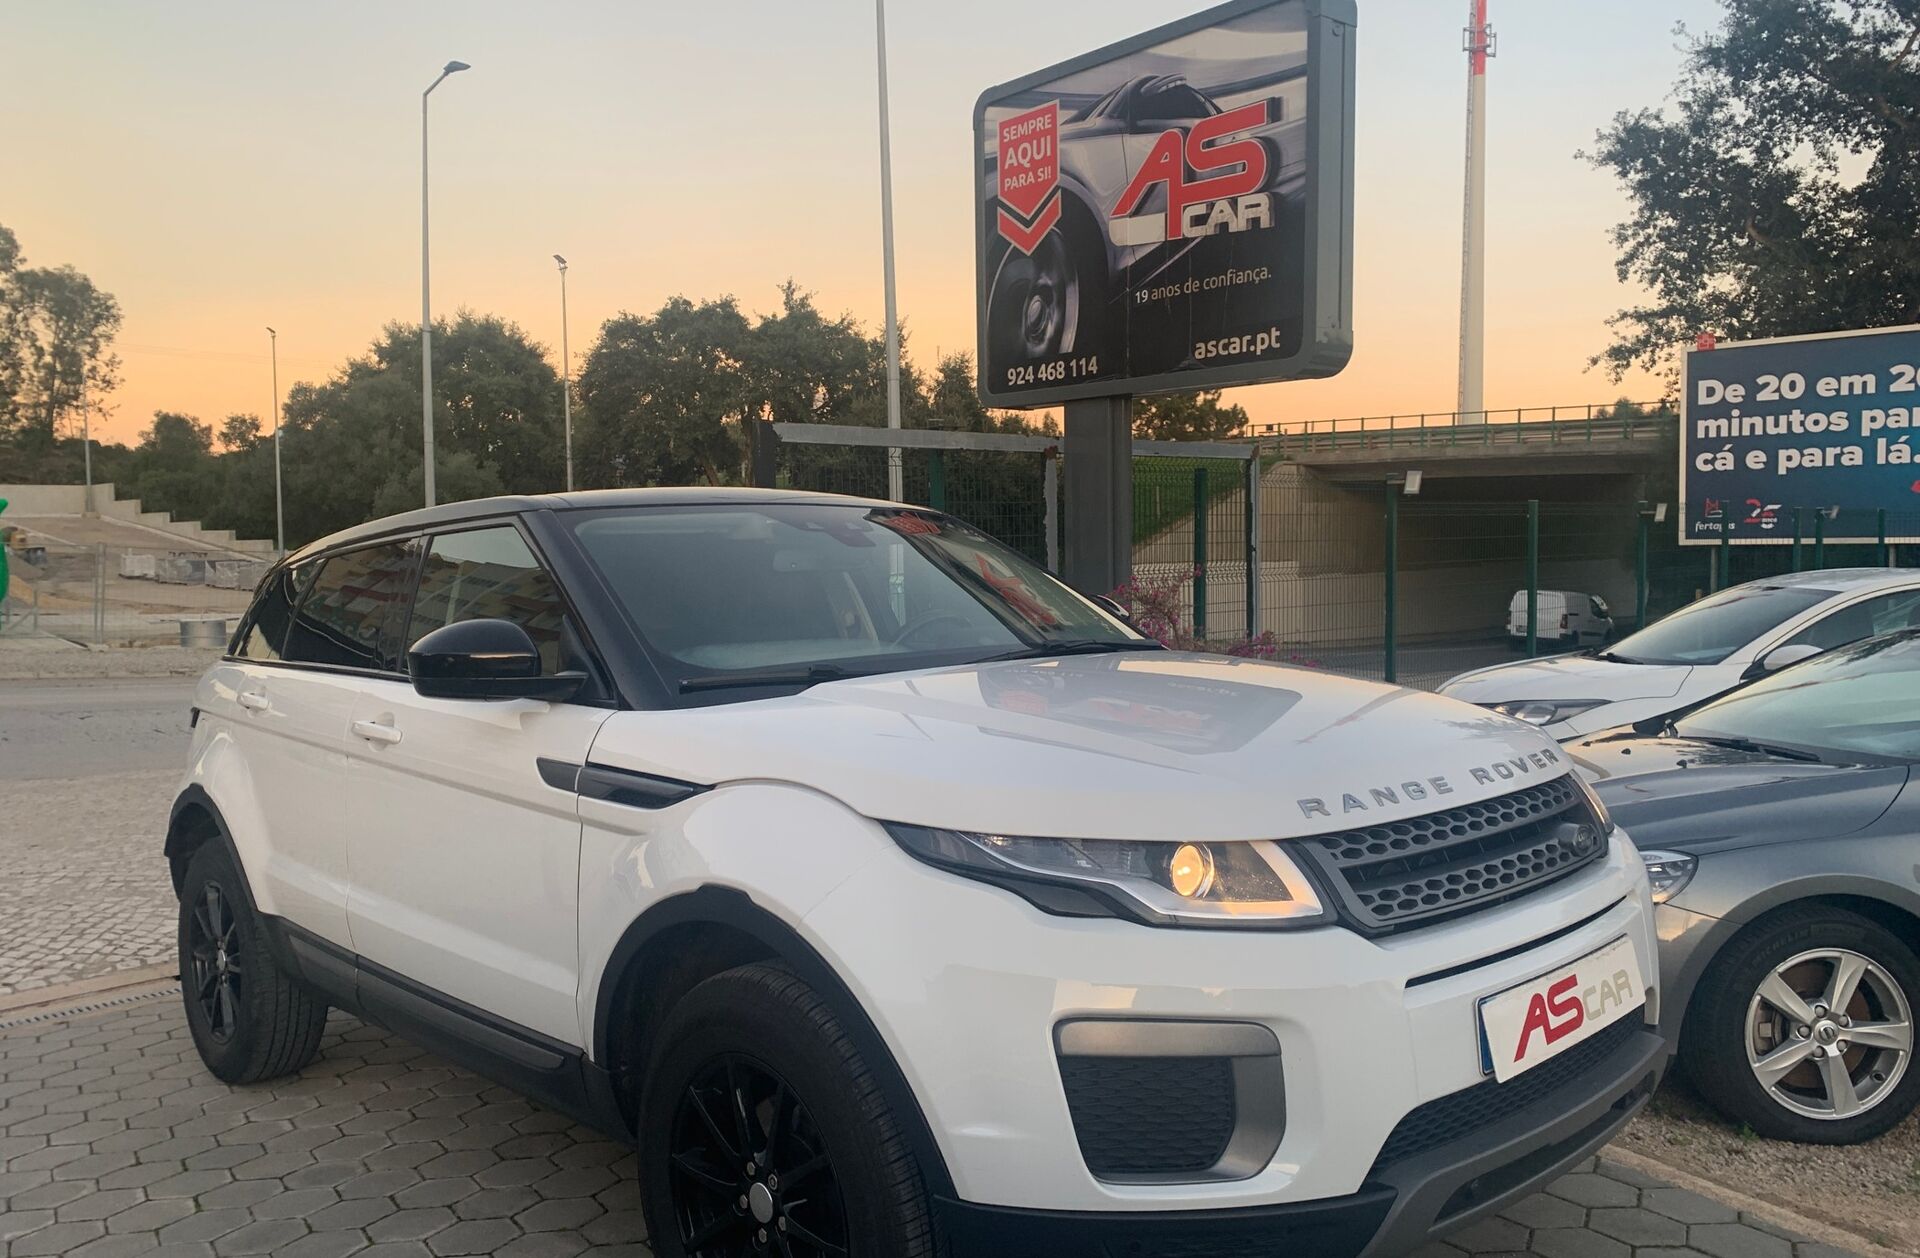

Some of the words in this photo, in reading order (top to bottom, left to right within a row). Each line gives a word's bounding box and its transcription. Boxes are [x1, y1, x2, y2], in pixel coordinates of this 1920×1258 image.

[1003, 114, 1053, 143] SEMPRE
[1004, 135, 1052, 169] AQUI
[1004, 171, 1035, 192] PARA
[1037, 165, 1052, 182] SI!
[1135, 289, 1149, 304] 19
[1151, 284, 1181, 300] anos
[1183, 277, 1200, 294] de
[1203, 266, 1272, 290] confiança.
[1194, 326, 1281, 360] ascar.pt
[1007, 365, 1034, 386] 924
[1037, 361, 1066, 381] 468
[1069, 355, 1098, 377] 114
[1697, 379, 1746, 406] De
[1756, 372, 1806, 402] 20
[1816, 373, 1876, 398] em
[1889, 363, 1920, 393] 2
[1697, 408, 1850, 439] minutos
[1695, 443, 1735, 472] cá
[1745, 449, 1767, 470] e
[1777, 445, 1864, 475] para
[1296, 775, 1454, 819] RANGE
[1468, 748, 1560, 786] ROVER
